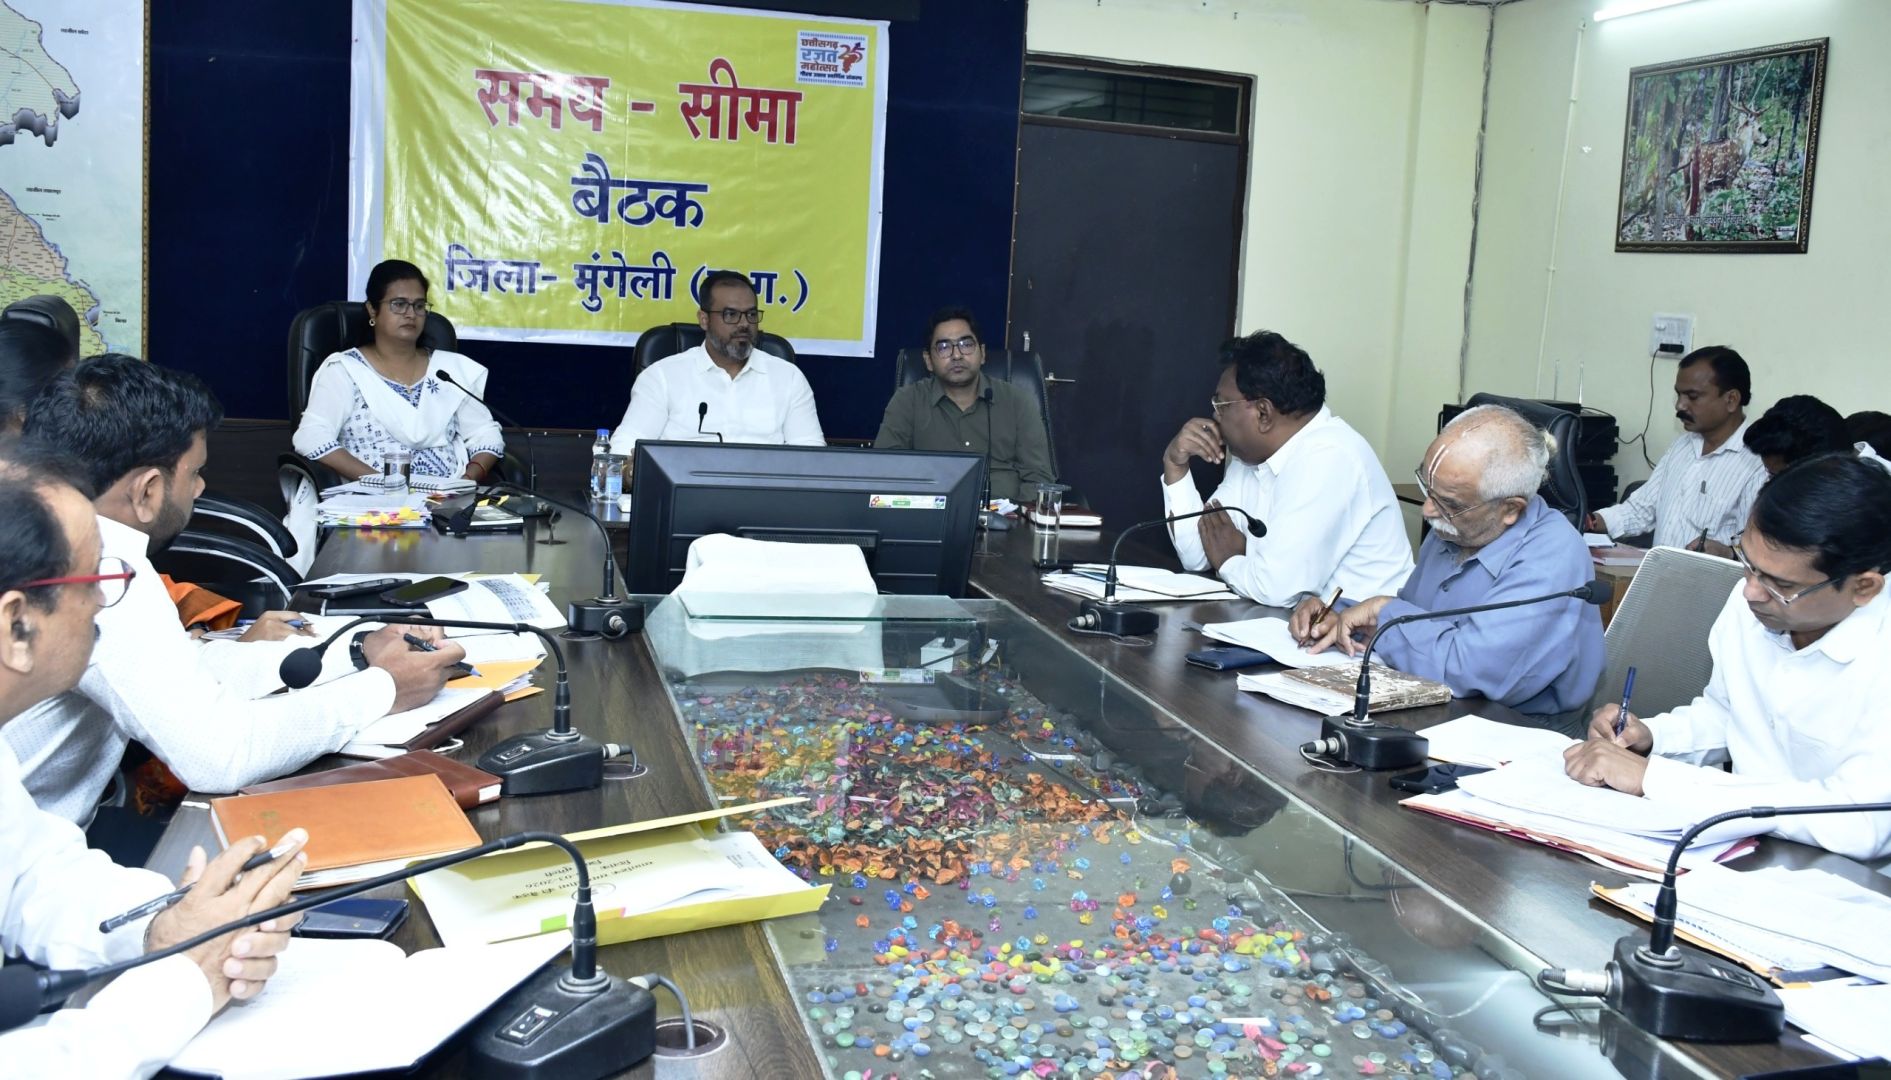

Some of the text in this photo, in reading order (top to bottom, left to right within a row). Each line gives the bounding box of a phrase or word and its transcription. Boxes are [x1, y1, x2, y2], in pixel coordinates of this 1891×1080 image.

[800, 47, 839, 63] रजत
[800, 60, 839, 73] महोत्सव
[475, 69, 610, 132] समय
[678, 58, 803, 145] सीमा
[570, 152, 709, 228] बैठक
[573, 250, 677, 312] मुंगेली
